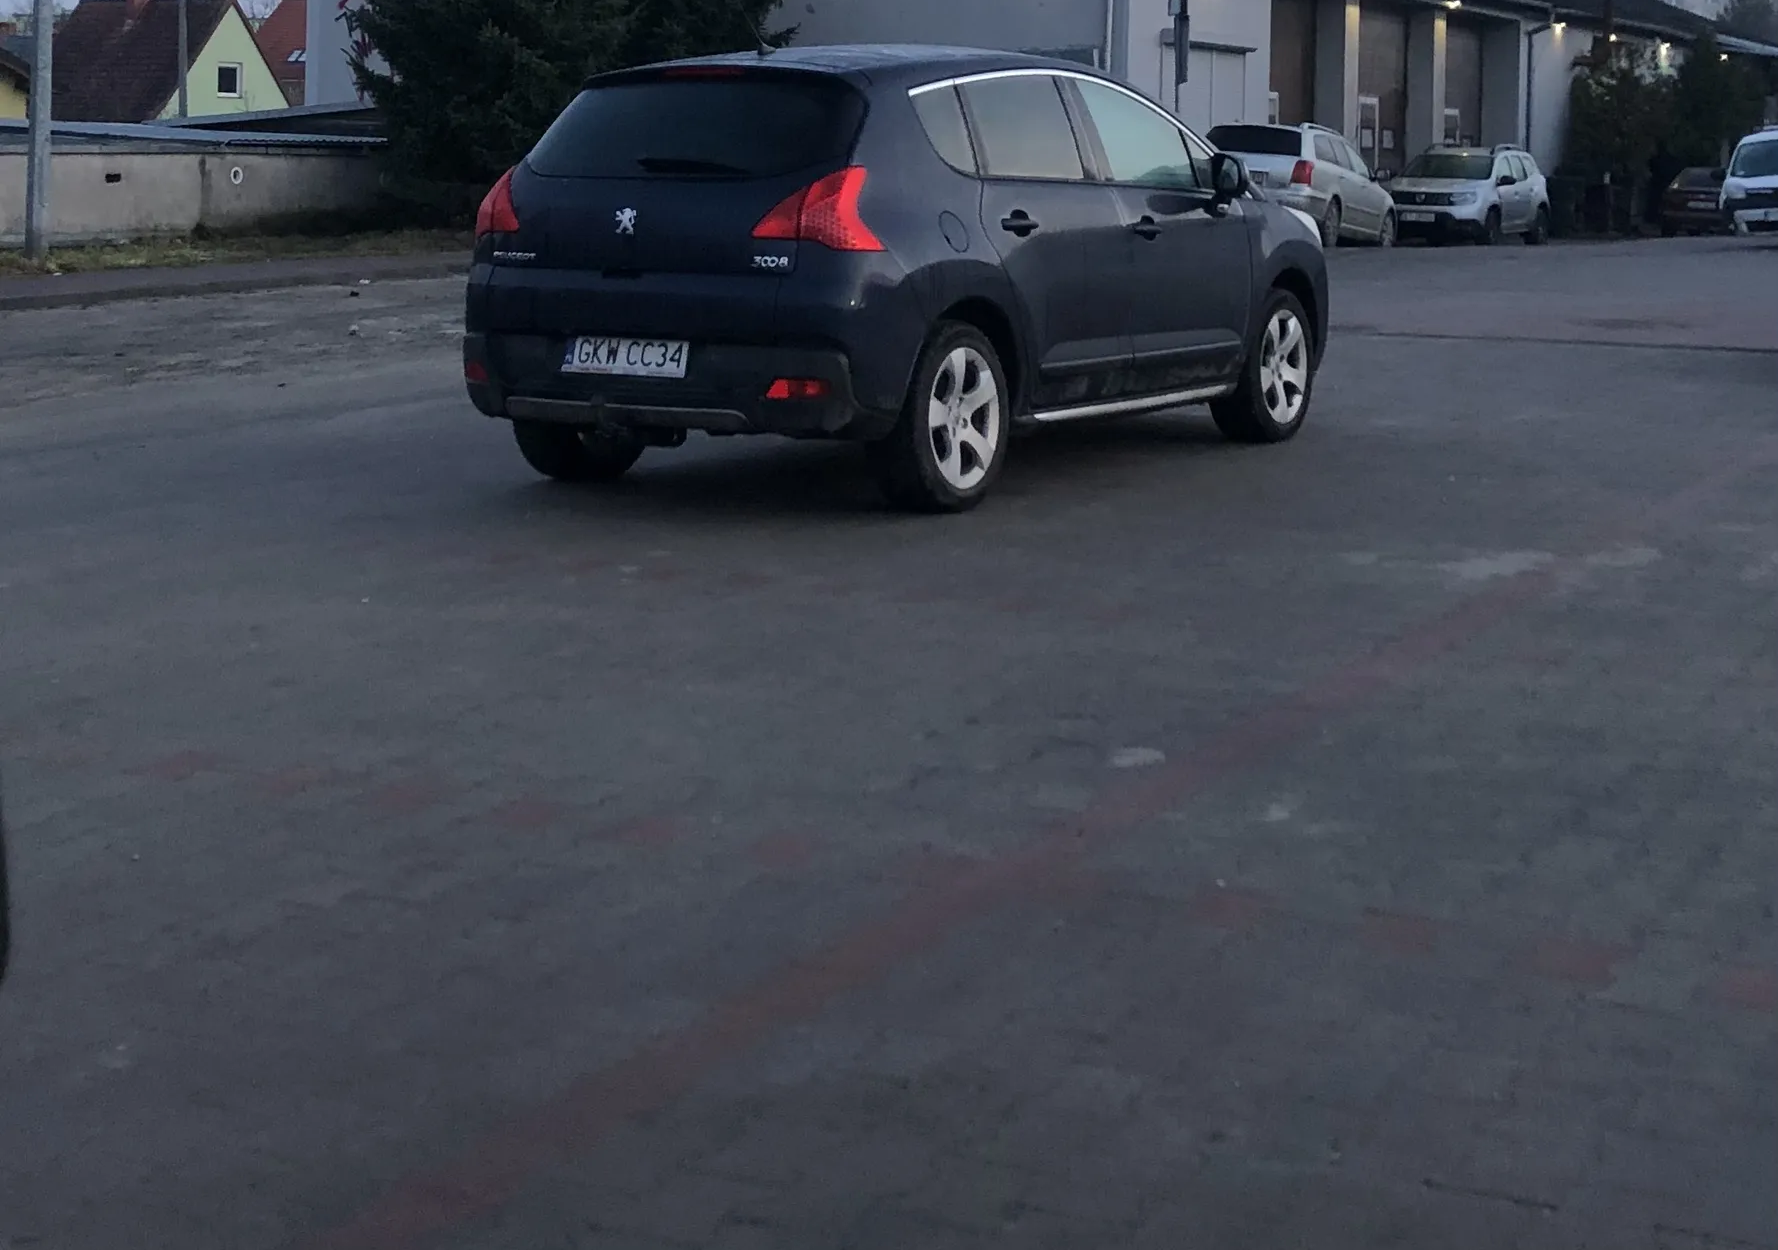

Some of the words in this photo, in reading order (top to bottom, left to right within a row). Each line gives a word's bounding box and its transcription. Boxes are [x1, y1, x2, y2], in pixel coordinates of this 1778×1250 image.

[751, 256, 789, 268] 3008
[578, 337, 621, 365] GKW
[626, 341, 684, 369] CC34
